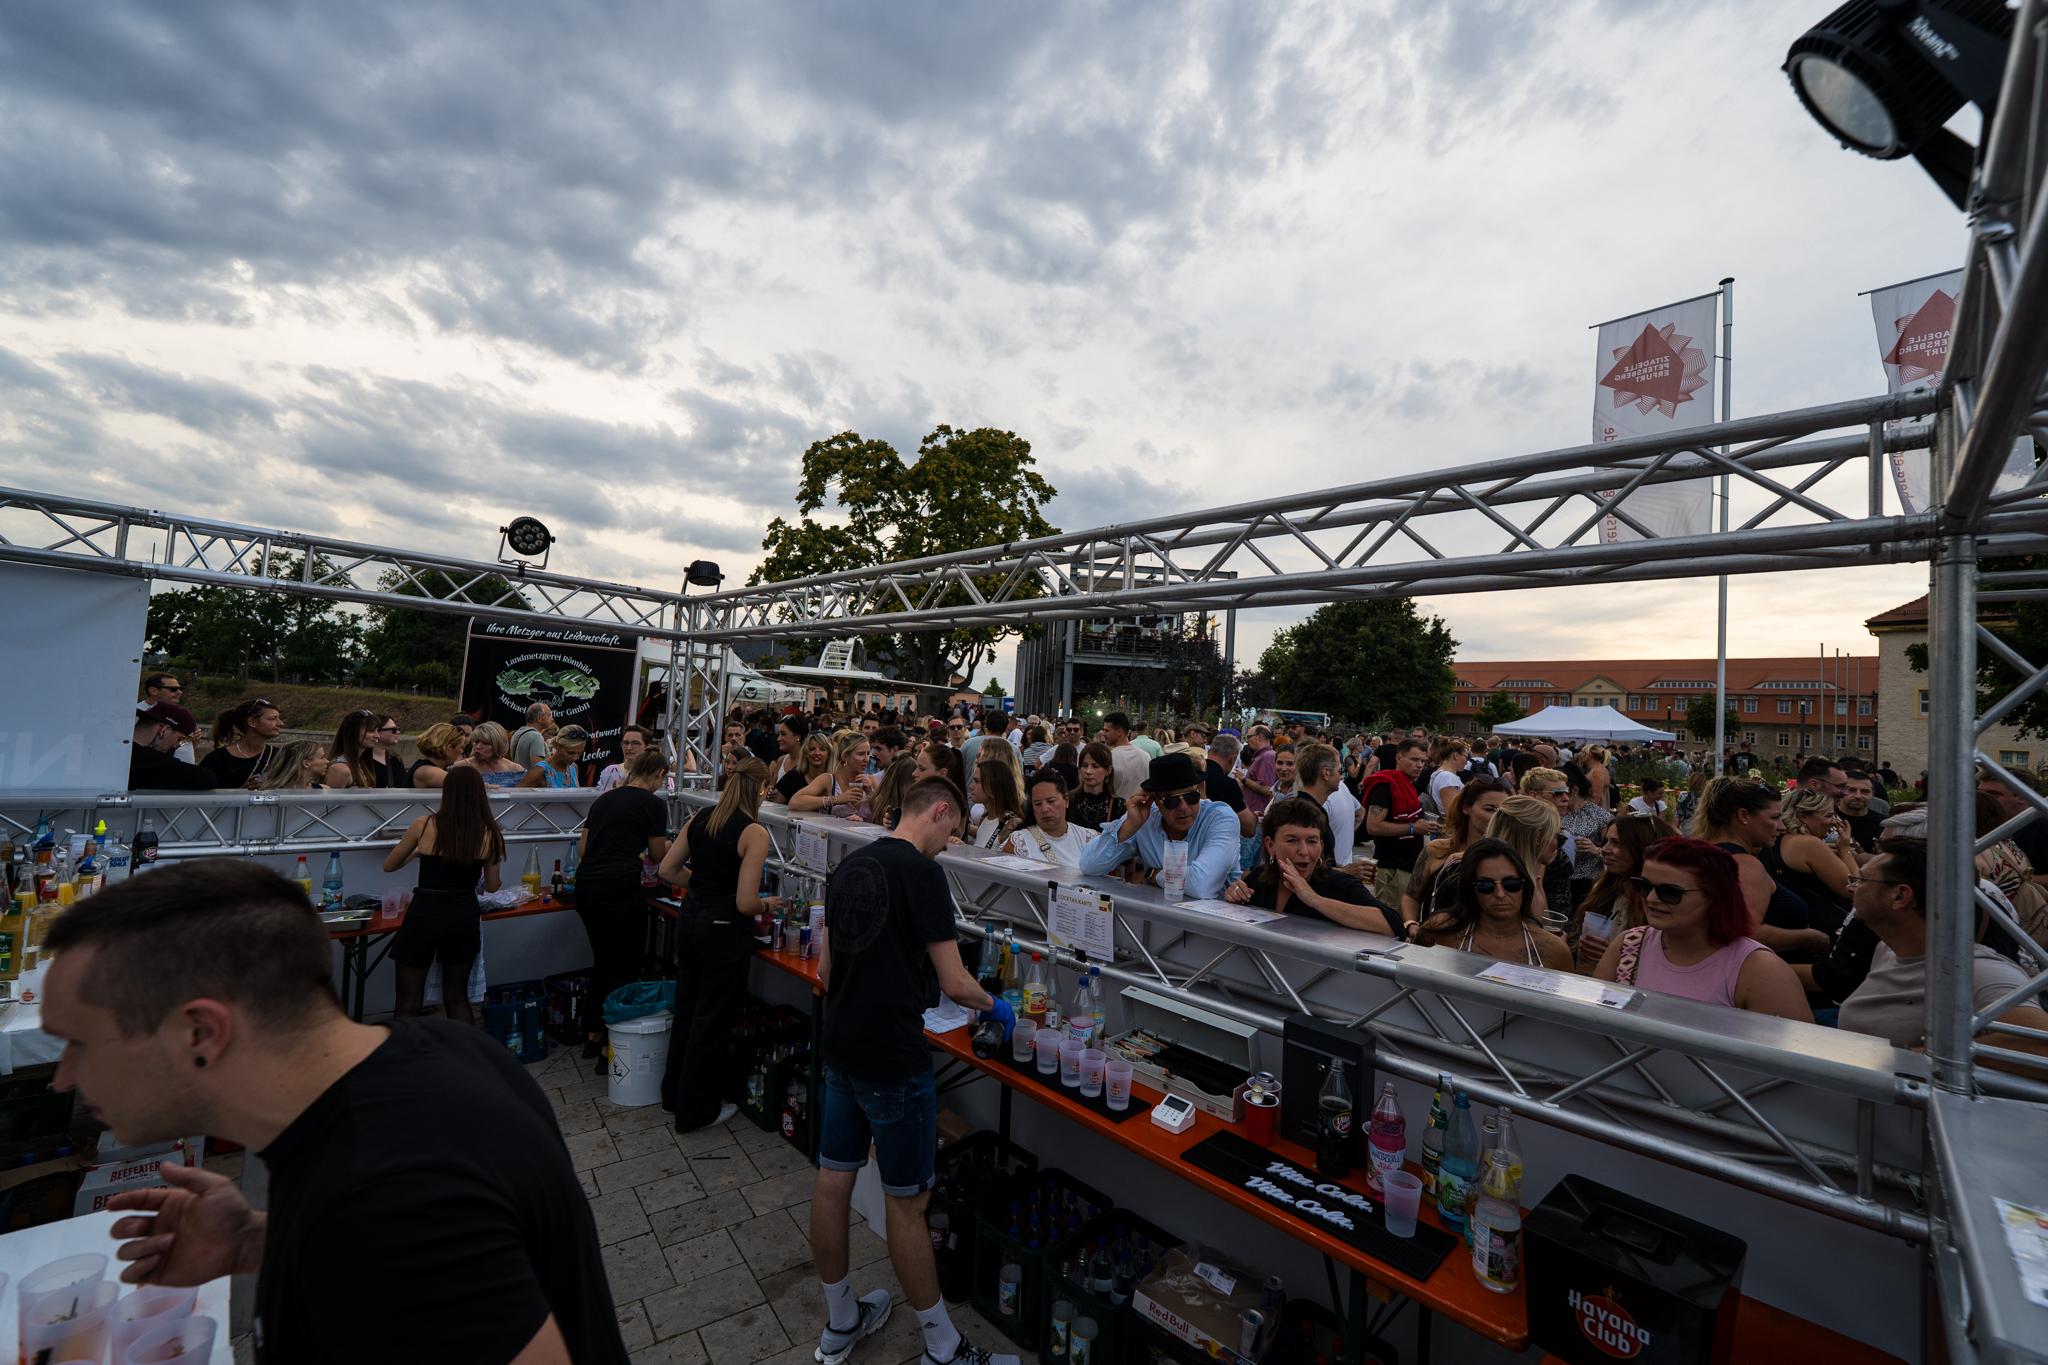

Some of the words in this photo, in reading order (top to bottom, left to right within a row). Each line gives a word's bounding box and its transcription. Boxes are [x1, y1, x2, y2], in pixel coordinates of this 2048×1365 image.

[486, 622, 506, 634] Ihre
[505, 624, 545, 640] Metzger
[546, 632, 563, 640] aus
[563, 630, 620, 646] Leidenschaft.
[505, 652, 562, 667] Landmetzgerei
[562, 655, 593, 675] Römhild
[566, 701, 591, 716] GmbH
[582, 748, 611, 762] Lecker
[110, 1160, 161, 1183] BEEFEATER
[1567, 1288, 1650, 1346] Havana
[1584, 1317, 1632, 1354] Club
